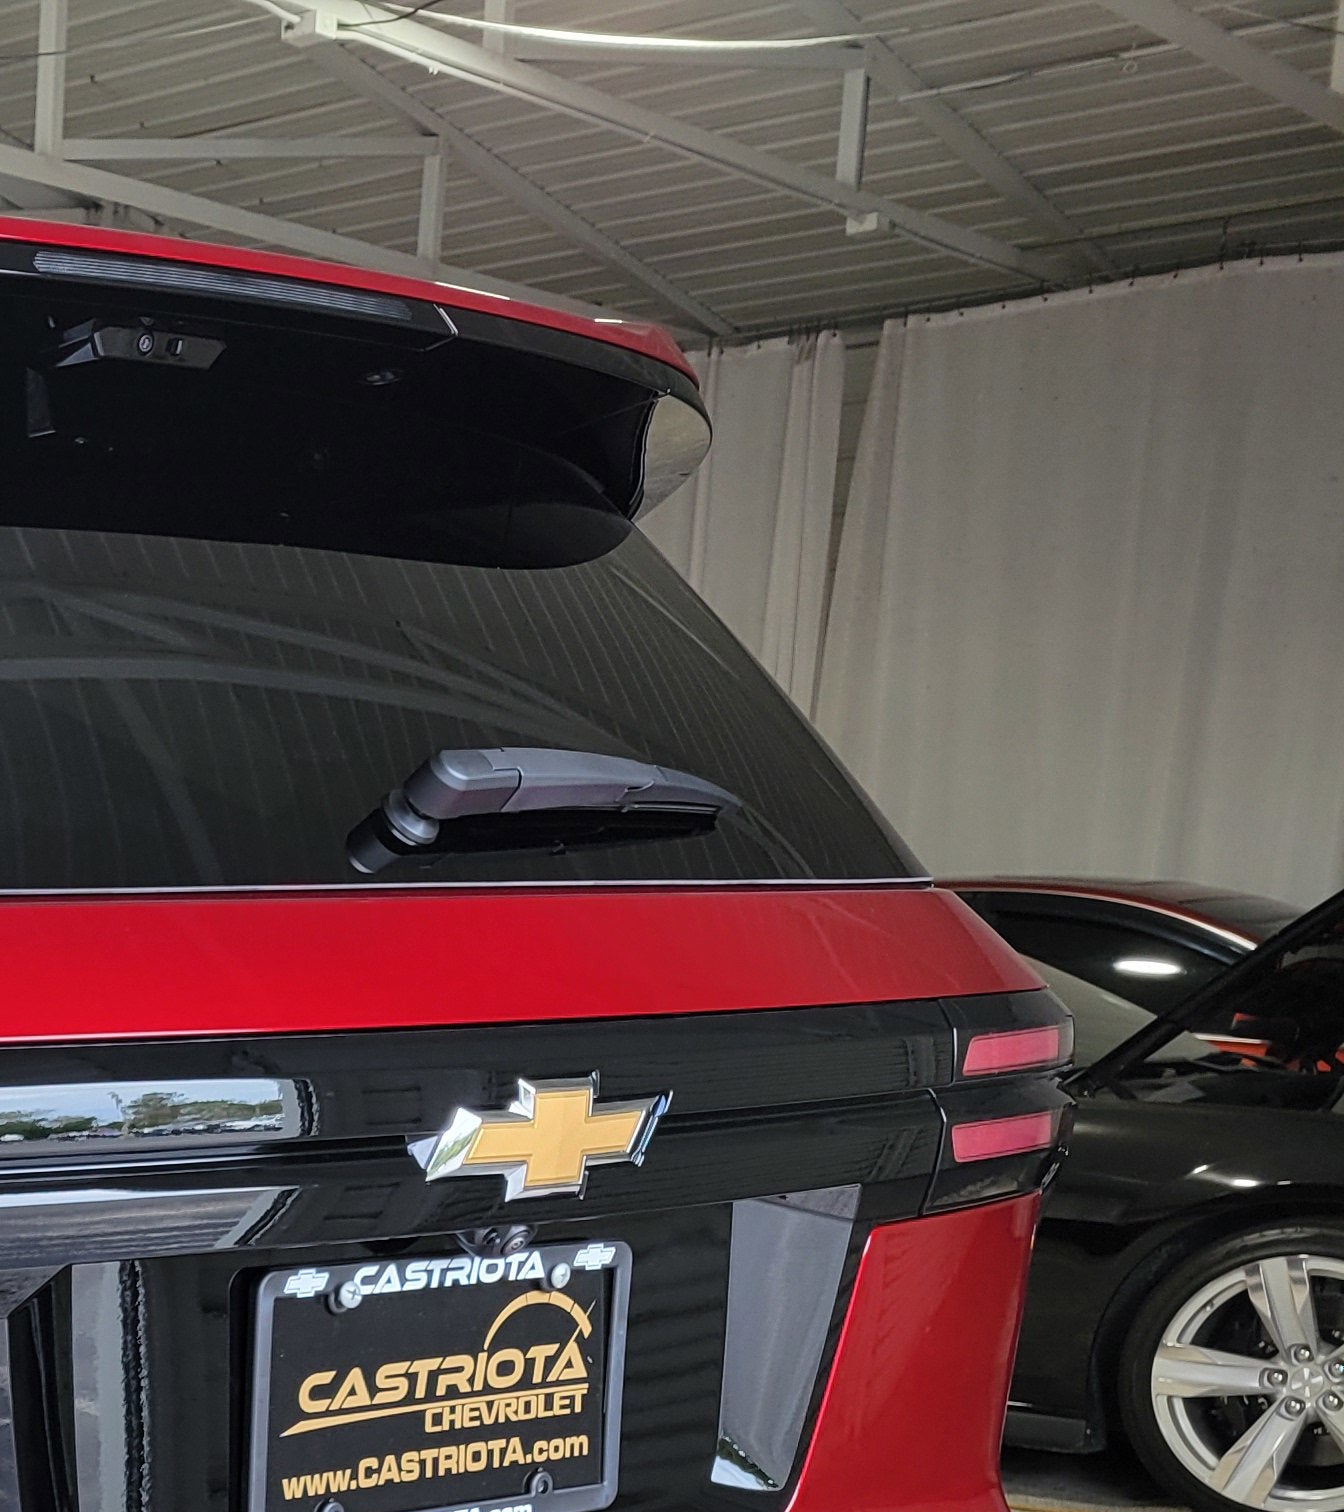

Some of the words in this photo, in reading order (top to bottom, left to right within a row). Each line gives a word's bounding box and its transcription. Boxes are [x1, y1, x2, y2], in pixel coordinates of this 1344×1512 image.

[353, 1251, 545, 1295] CASTRIOTA
[298, 1341, 589, 1414] CASTRIOTA
[424, 1388, 589, 1434] CHEVROLET
[281, 1433, 590, 1501] www.CASTRIOTA.com
